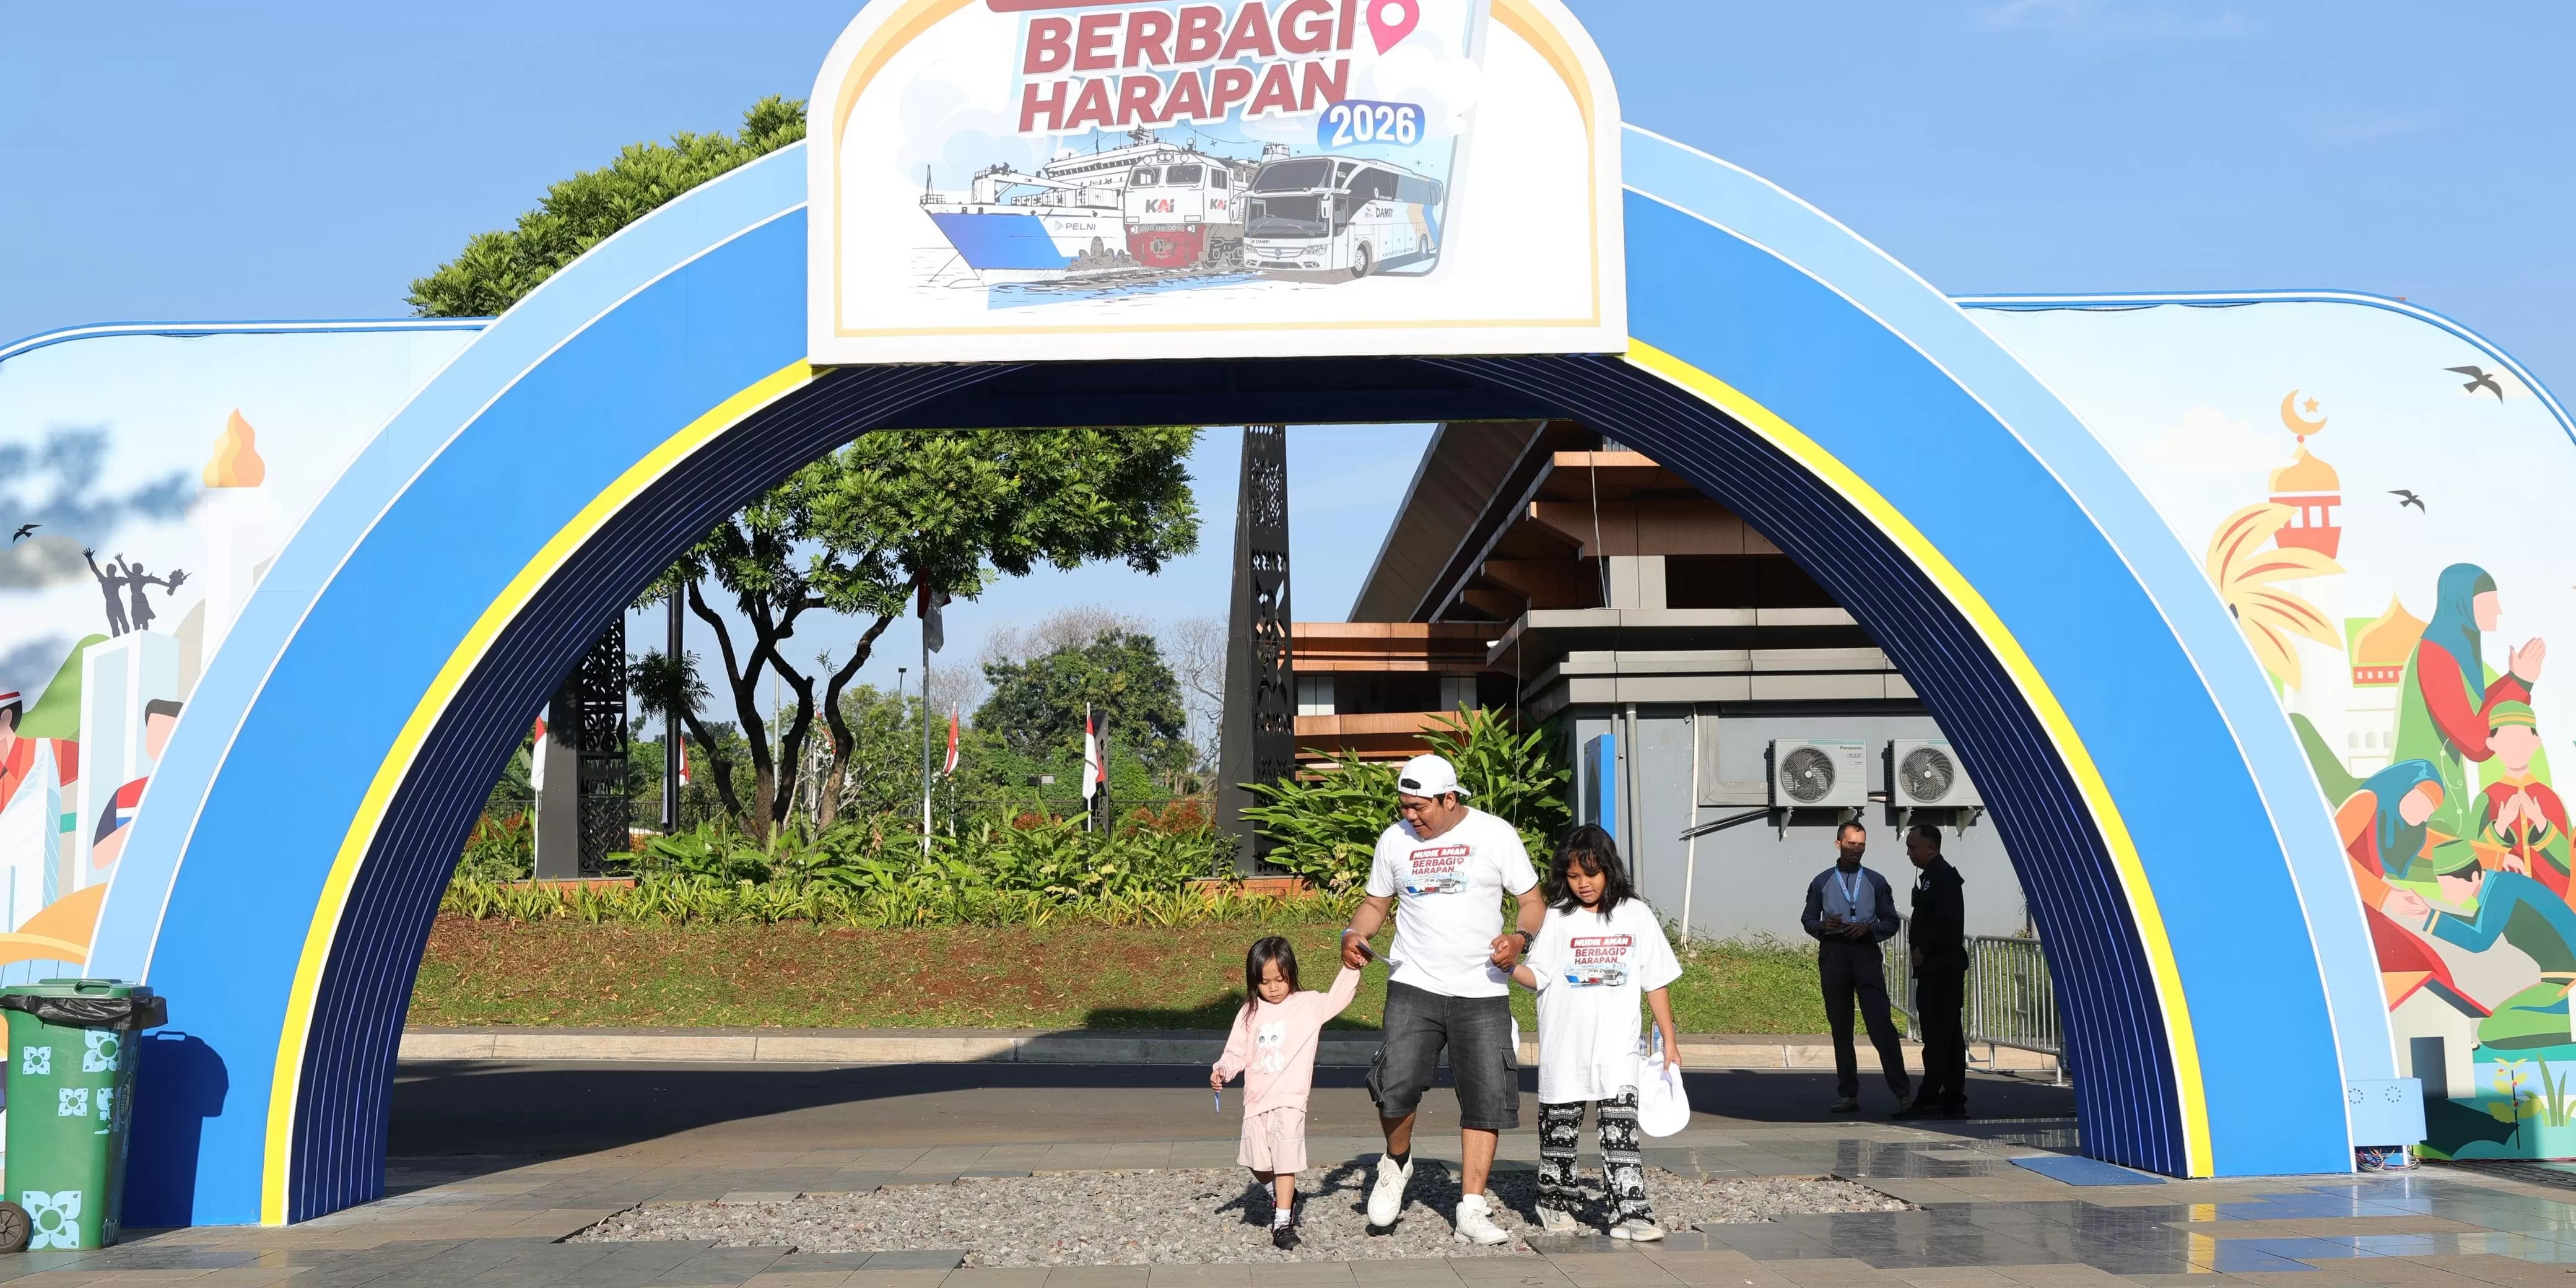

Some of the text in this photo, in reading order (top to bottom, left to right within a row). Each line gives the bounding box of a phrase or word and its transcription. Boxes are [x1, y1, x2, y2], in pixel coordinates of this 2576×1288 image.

[1022, 0, 1359, 75] BERBAGI
[1019, 58, 1351, 133] HARAPAN
[1329, 104, 1416, 147] 2026
[1065, 222, 1096, 231] PELNI
[1412, 846, 1467, 859] MUDIK AMAN
[1412, 857, 1456, 868] BERBAGI
[1411, 866, 1455, 876] HARAPAN
[1573, 937, 1629, 947] MUDIK AMAN
[1575, 947, 1619, 957] BERBAGI
[1574, 956, 1617, 965] HARAPAN
